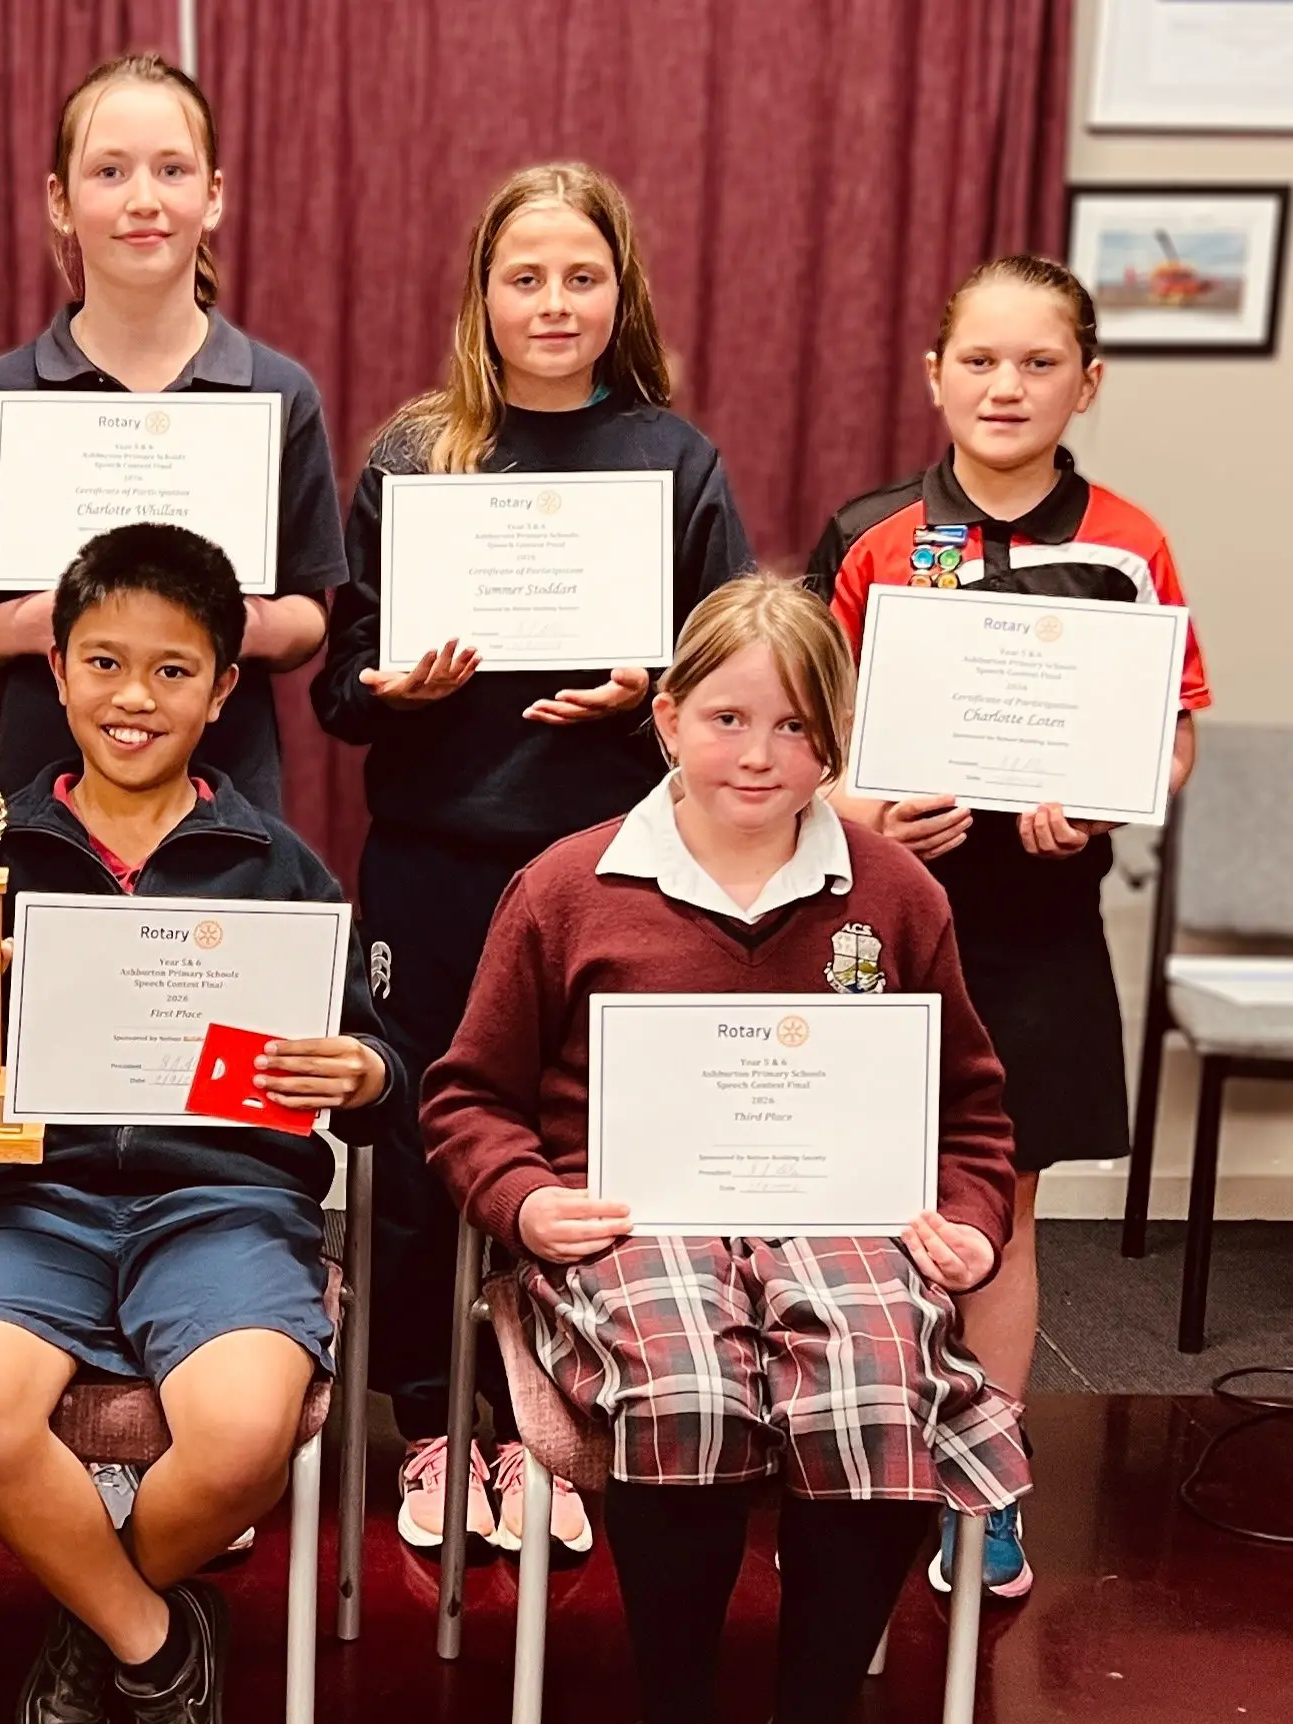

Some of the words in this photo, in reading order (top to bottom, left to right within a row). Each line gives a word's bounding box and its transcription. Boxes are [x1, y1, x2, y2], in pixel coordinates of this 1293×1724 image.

[98, 416, 140, 429] Rotary
[77, 503, 131, 516] Charlotte
[135, 503, 188, 517] Whillans
[490, 497, 532, 510] Rotary
[474, 585, 524, 596] Summer
[525, 582, 577, 595] Stoddart
[983, 618, 1030, 634] Rotary
[963, 708, 1024, 725] Charlotte
[1027, 714, 1065, 728] Loten
[140, 926, 190, 942] Rotary
[841, 923, 873, 936] ACS
[160, 958, 179, 966] Year
[168, 970, 203, 978] Primary
[134, 980, 164, 988] Speech
[151, 1009, 173, 1018] First
[176, 1010, 202, 1018] Place
[718, 1023, 772, 1041] Rotary
[734, 1113, 762, 1121] Third
[765, 1113, 793, 1121] Place
